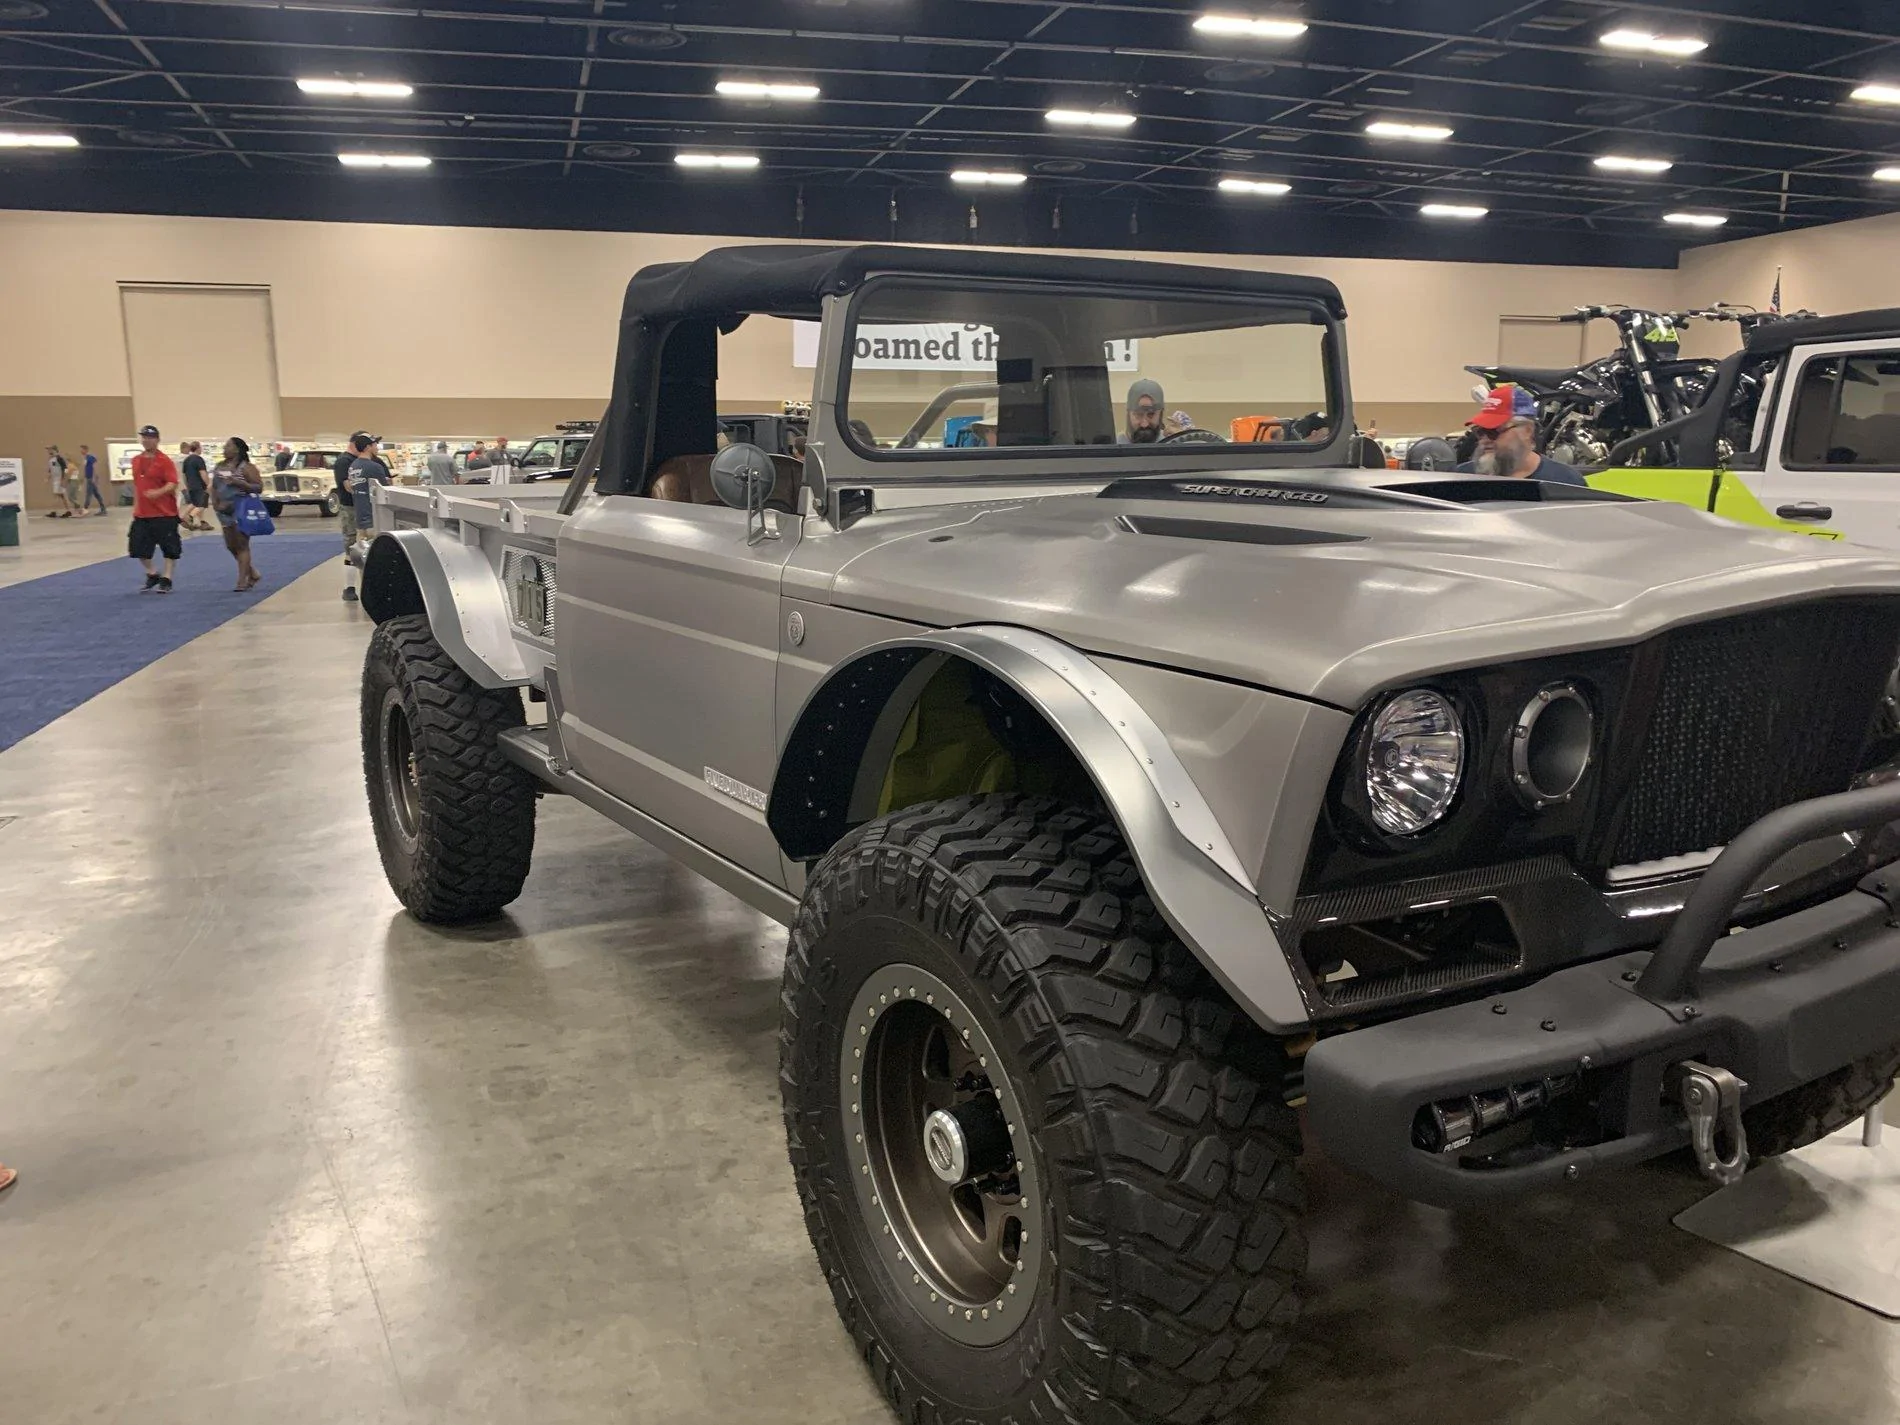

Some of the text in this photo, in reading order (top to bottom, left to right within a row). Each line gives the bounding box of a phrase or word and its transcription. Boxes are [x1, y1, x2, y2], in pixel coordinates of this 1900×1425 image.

[855, 332, 999, 361] oamed th
[1181, 485, 1328, 502] SUPERCHARGED
